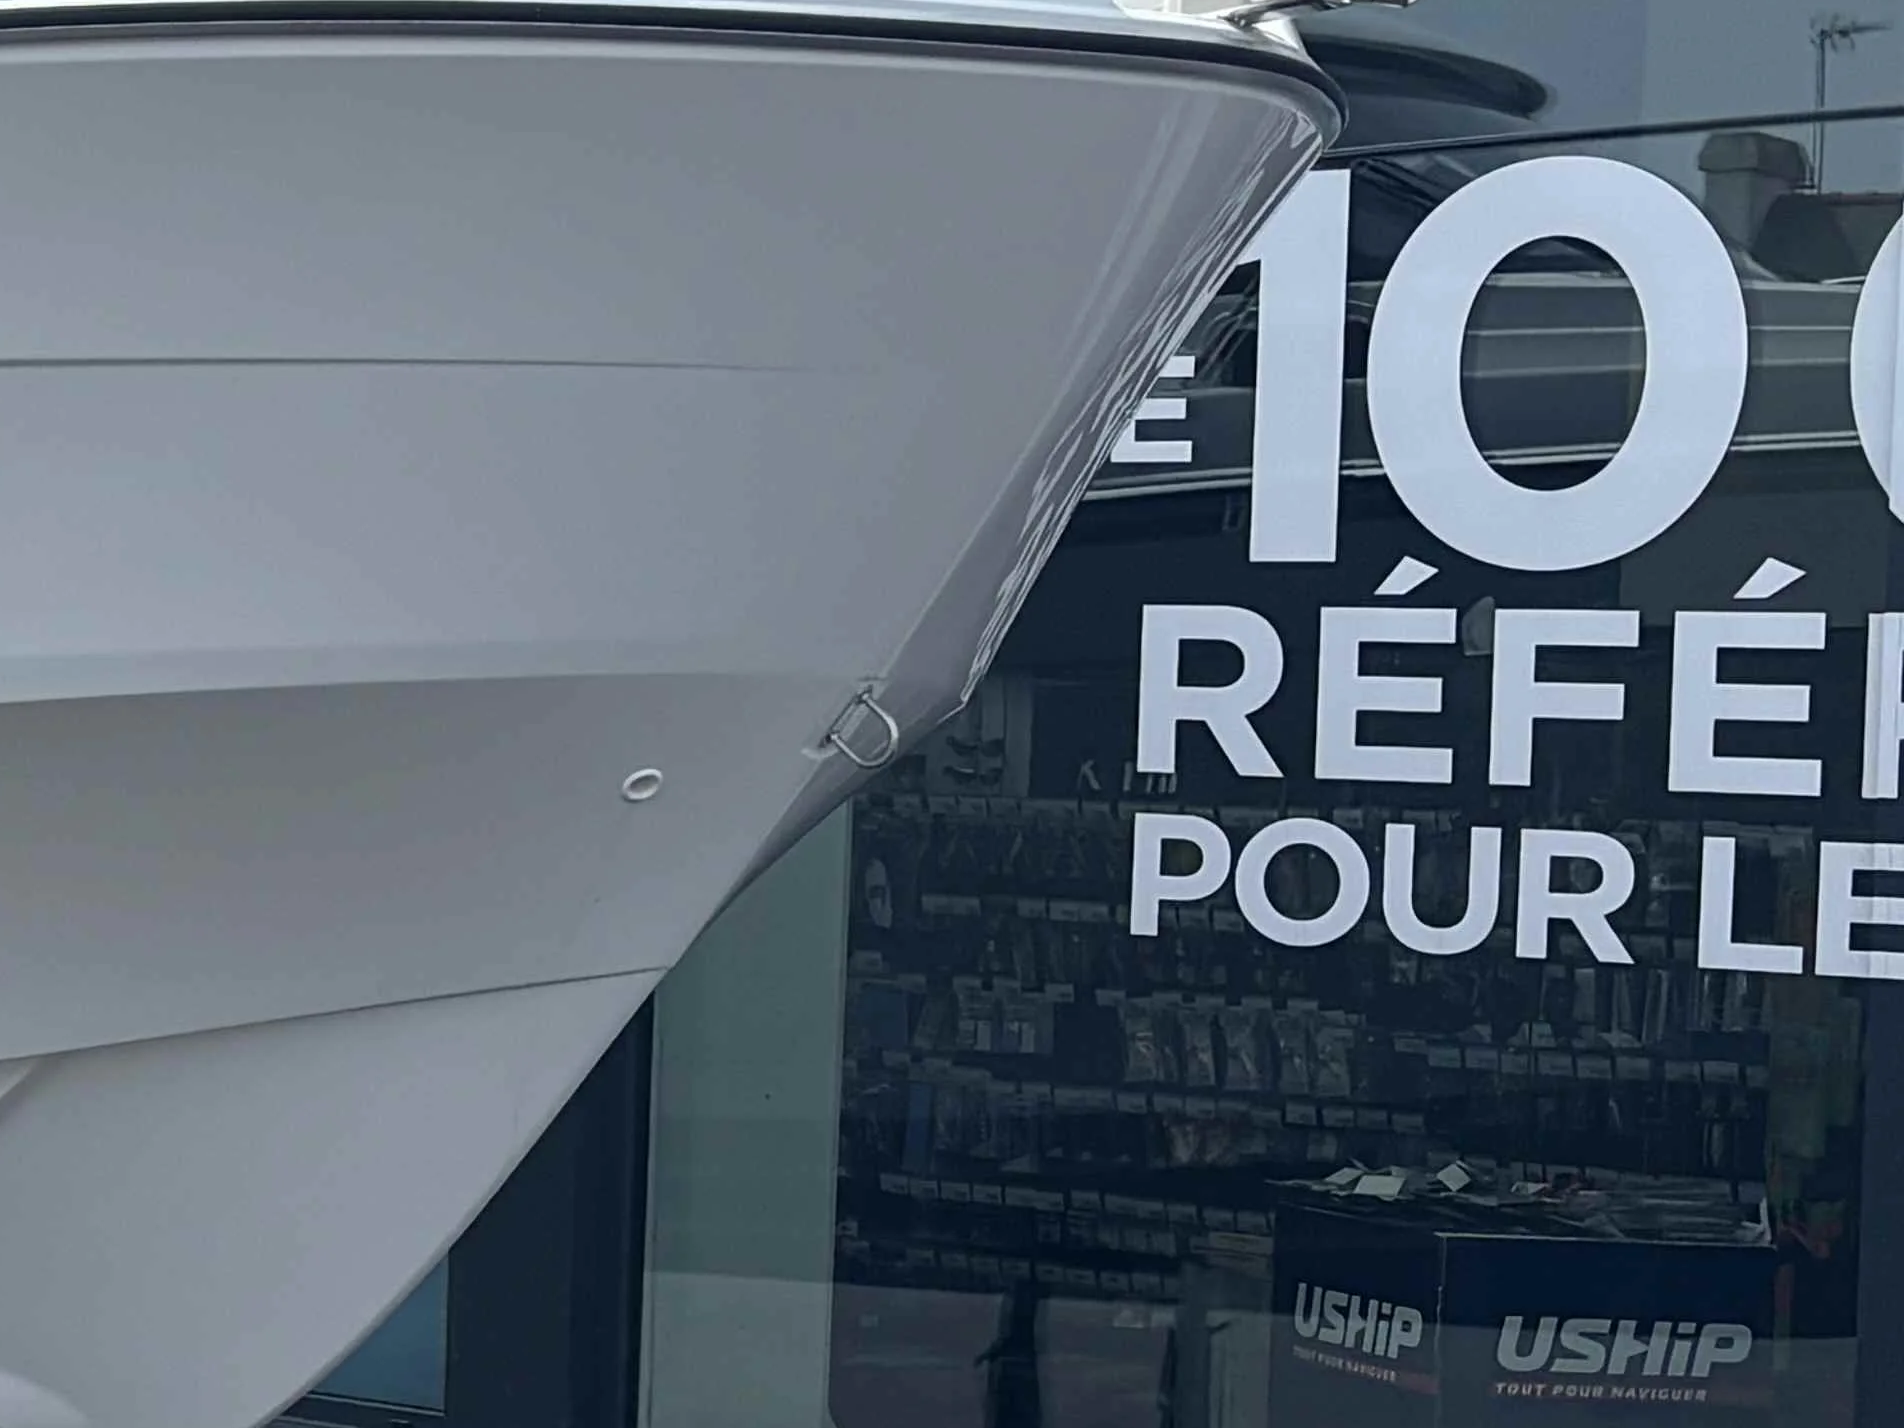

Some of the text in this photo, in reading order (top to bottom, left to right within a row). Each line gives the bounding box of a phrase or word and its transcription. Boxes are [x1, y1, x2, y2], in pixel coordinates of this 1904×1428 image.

[1234, 155, 1749, 572] 10
[1128, 811, 1904, 980] POUR LE
[1495, 1383, 1708, 1402] TOUT POUR NAVIGUER
